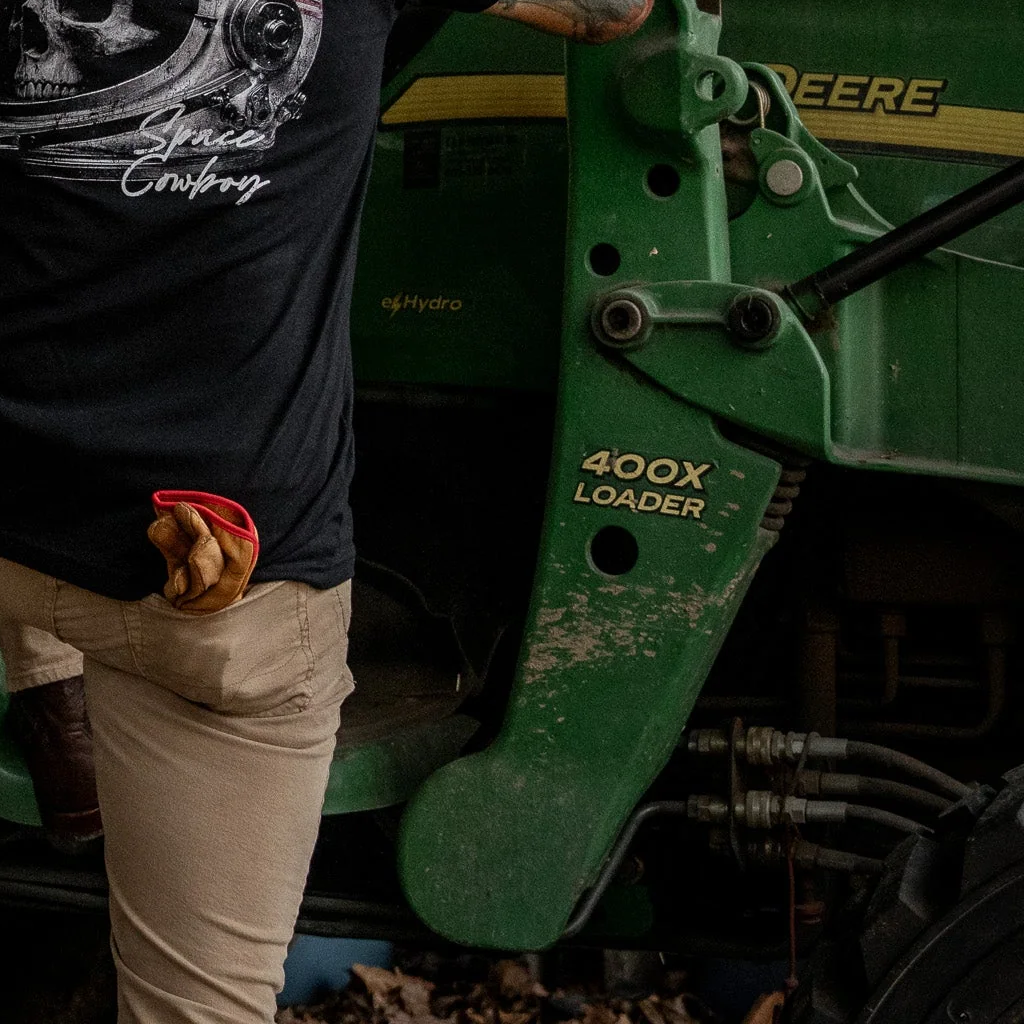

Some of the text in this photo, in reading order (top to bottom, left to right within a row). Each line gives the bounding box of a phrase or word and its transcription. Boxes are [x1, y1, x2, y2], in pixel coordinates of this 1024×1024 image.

[133, 103, 266, 162] Space
[121, 153, 271, 205] Cowboy
[580, 448, 712, 491] 400X
[573, 481, 706, 520] LOADER
